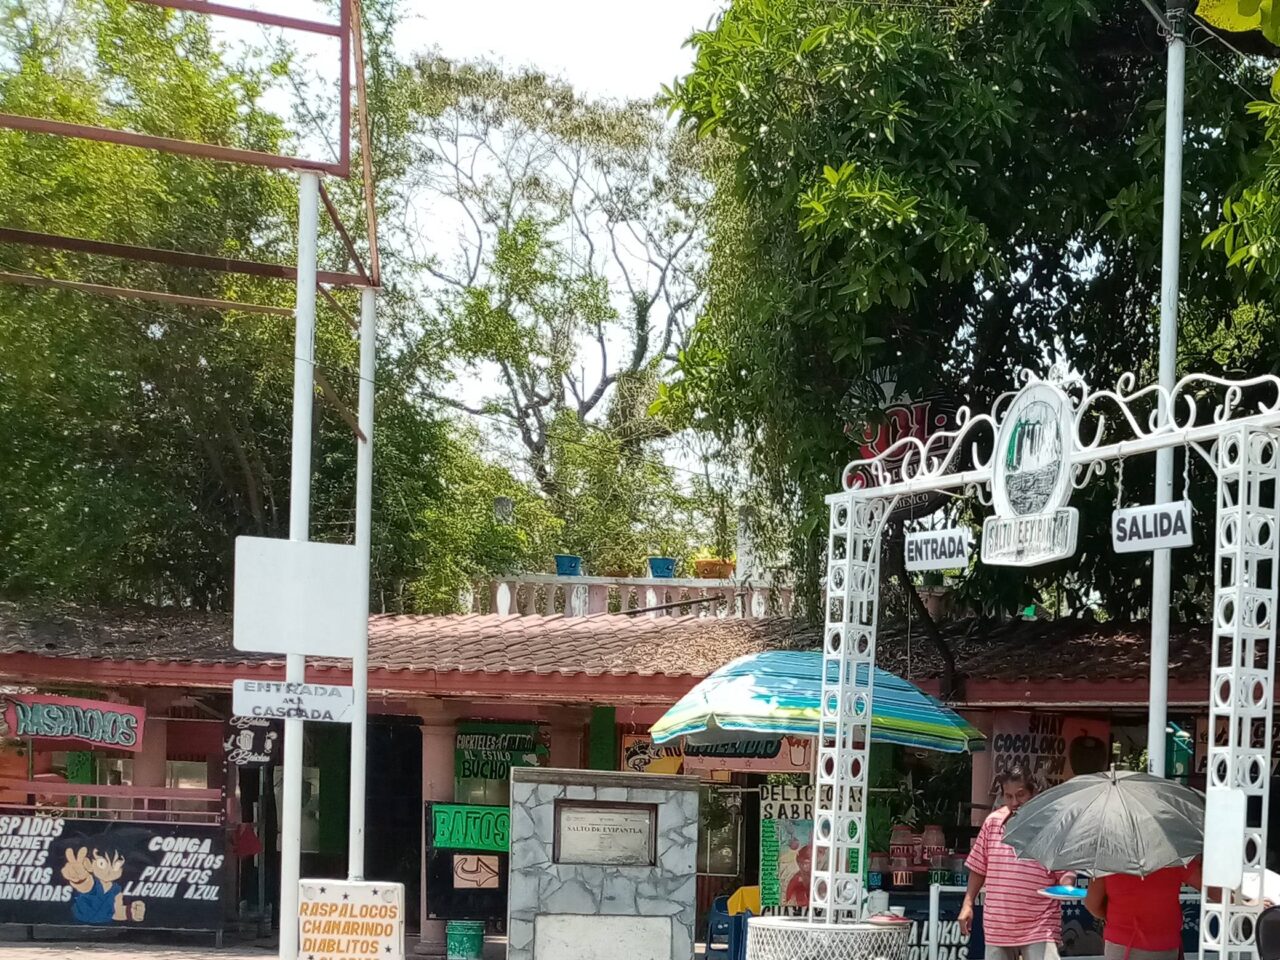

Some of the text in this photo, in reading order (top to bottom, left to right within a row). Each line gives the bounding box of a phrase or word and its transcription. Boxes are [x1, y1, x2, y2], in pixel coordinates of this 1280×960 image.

[1116, 509, 1188, 542] SALIDA
[907, 540, 966, 562] ENTRADA
[244, 682, 343, 697] ENTRADA
[252, 705, 334, 720] CASCADA
[482, 750, 511, 761] ESTILO
[462, 760, 510, 779] BUCHO
[433, 810, 511, 848] BAÑOS
[0, 835, 54, 849] URMET
[148, 836, 212, 853] CONGA
[140, 866, 213, 884] PITUFOS
[123, 880, 220, 900] LAGUNA AZUL
[300, 902, 398, 919] RASPALOCOS
[302, 920, 394, 937] CHAMARINDO
[302, 938, 379, 954] DIABLITOS
